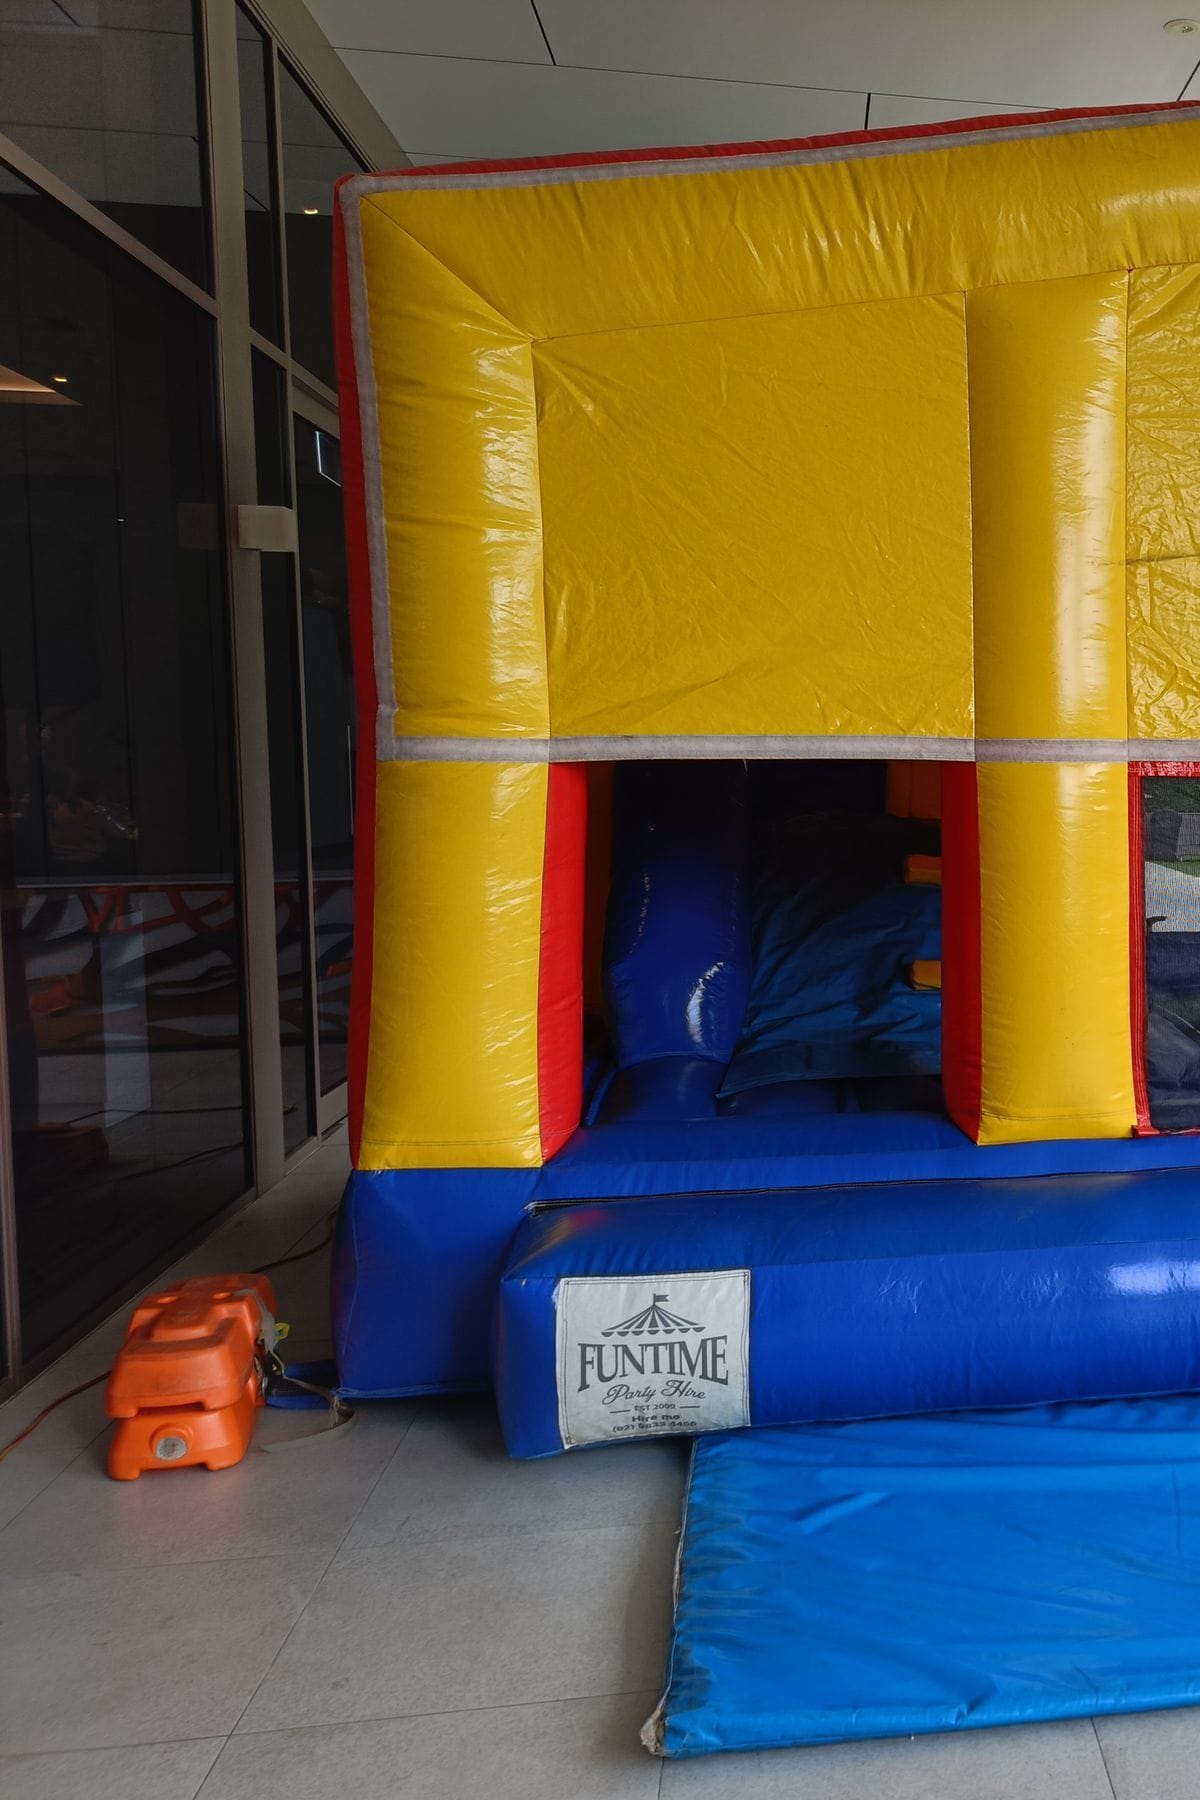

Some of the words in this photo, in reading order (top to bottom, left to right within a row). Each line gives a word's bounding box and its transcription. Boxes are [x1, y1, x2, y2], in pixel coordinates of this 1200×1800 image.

[577, 1335, 728, 1393] FUNTIME
[602, 1384, 656, 1405] Party
[660, 1379, 706, 1400] Hire
